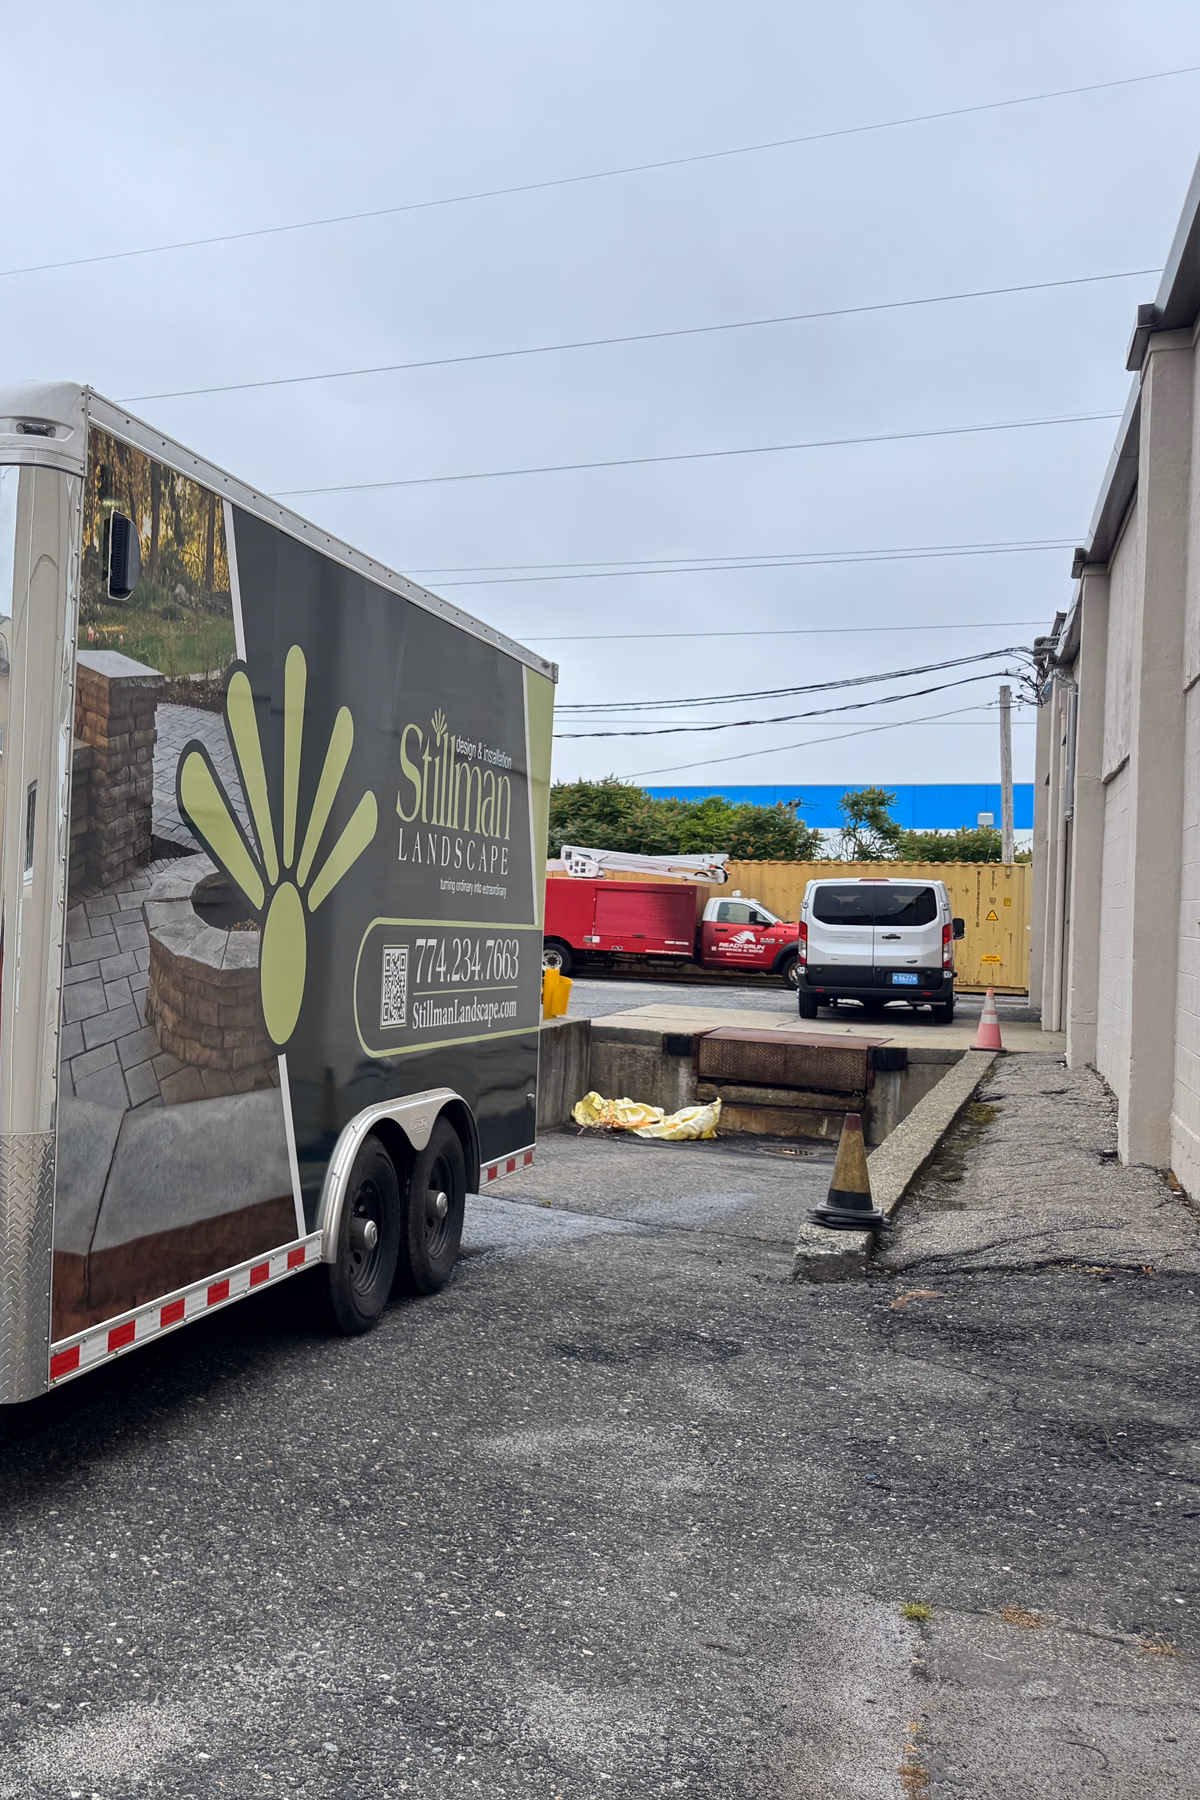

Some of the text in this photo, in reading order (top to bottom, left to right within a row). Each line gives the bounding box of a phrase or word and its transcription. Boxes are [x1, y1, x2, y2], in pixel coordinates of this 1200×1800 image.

[456, 734, 477, 761] design
[477, 741, 483, 760] &
[396, 723, 511, 841] Stillman
[398, 827, 509, 876] LANDSCAPE
[415, 938, 520, 984] 774.234.7663
[412, 996, 517, 1030] StillmanLandscape.com
